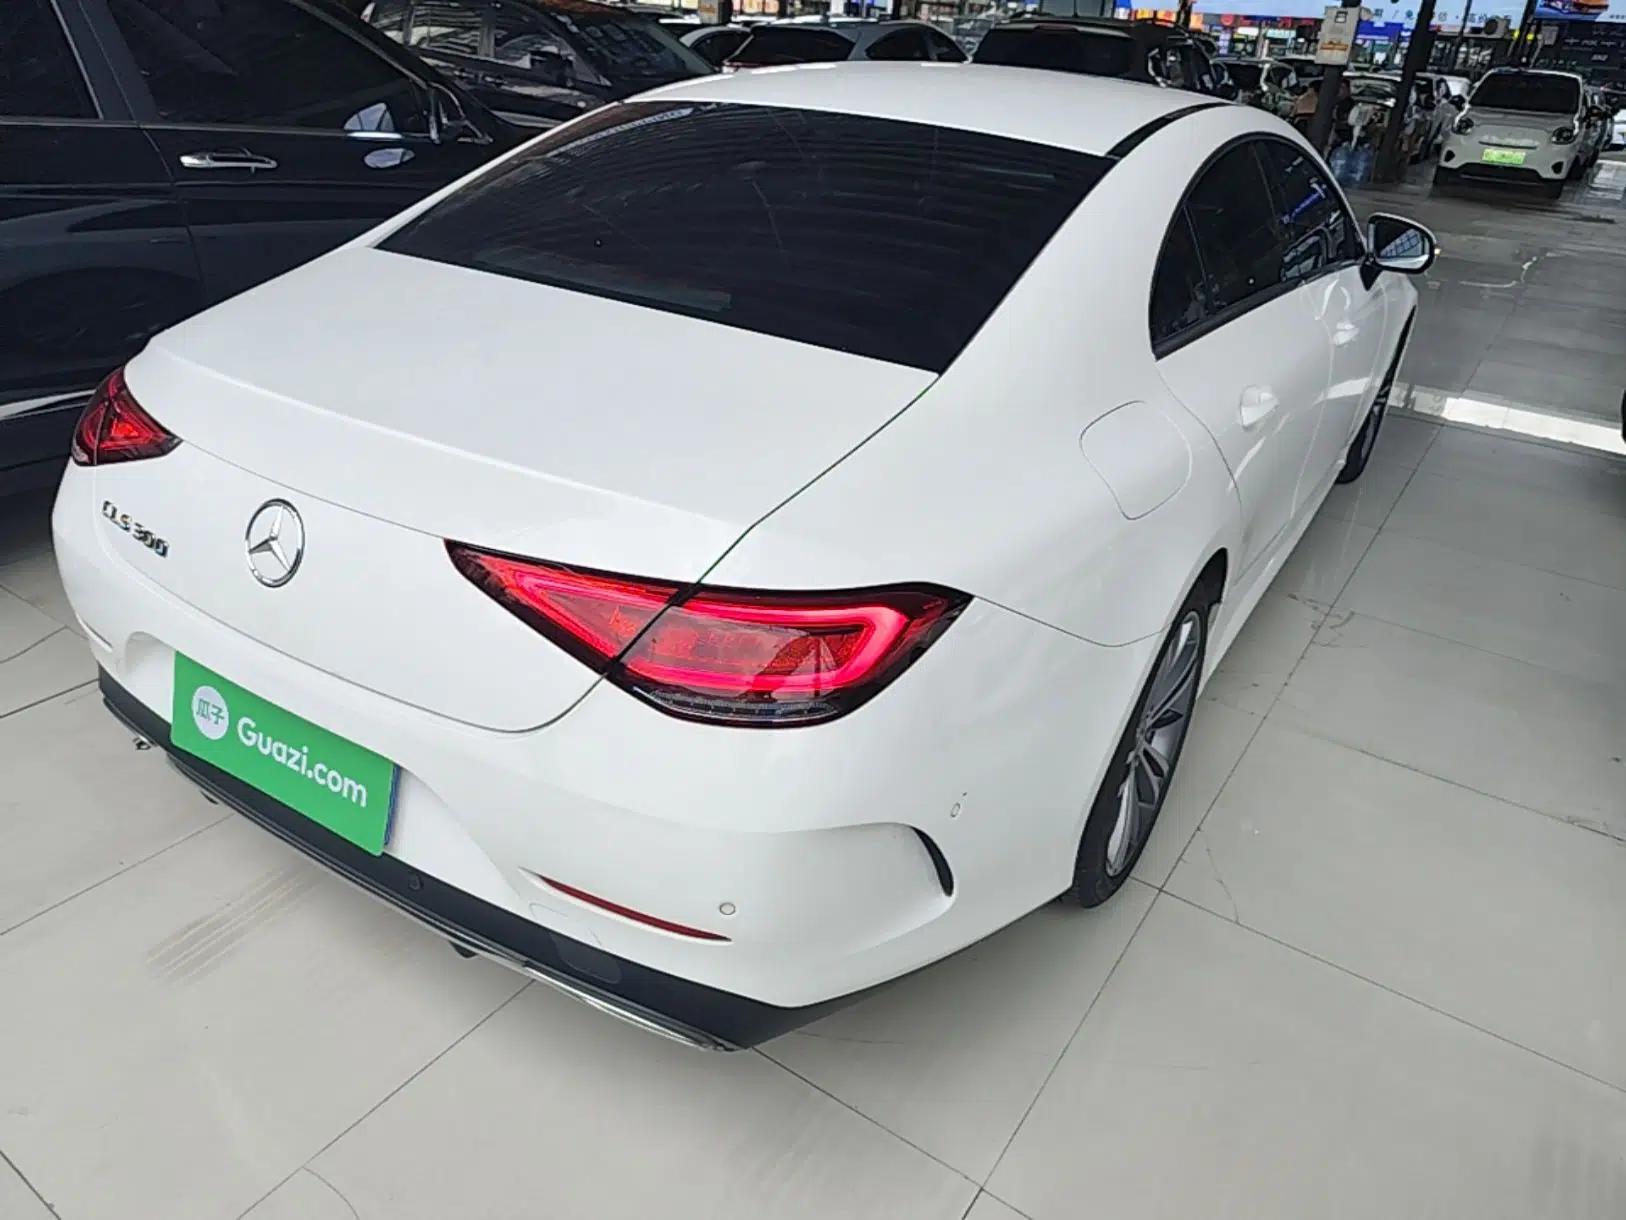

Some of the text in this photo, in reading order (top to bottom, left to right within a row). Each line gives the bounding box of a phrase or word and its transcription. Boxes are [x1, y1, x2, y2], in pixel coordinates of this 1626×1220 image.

[102, 500, 168, 557] CLS 300
[196, 699, 224, 725] 瓜子
[237, 716, 368, 807] Guazi.com
